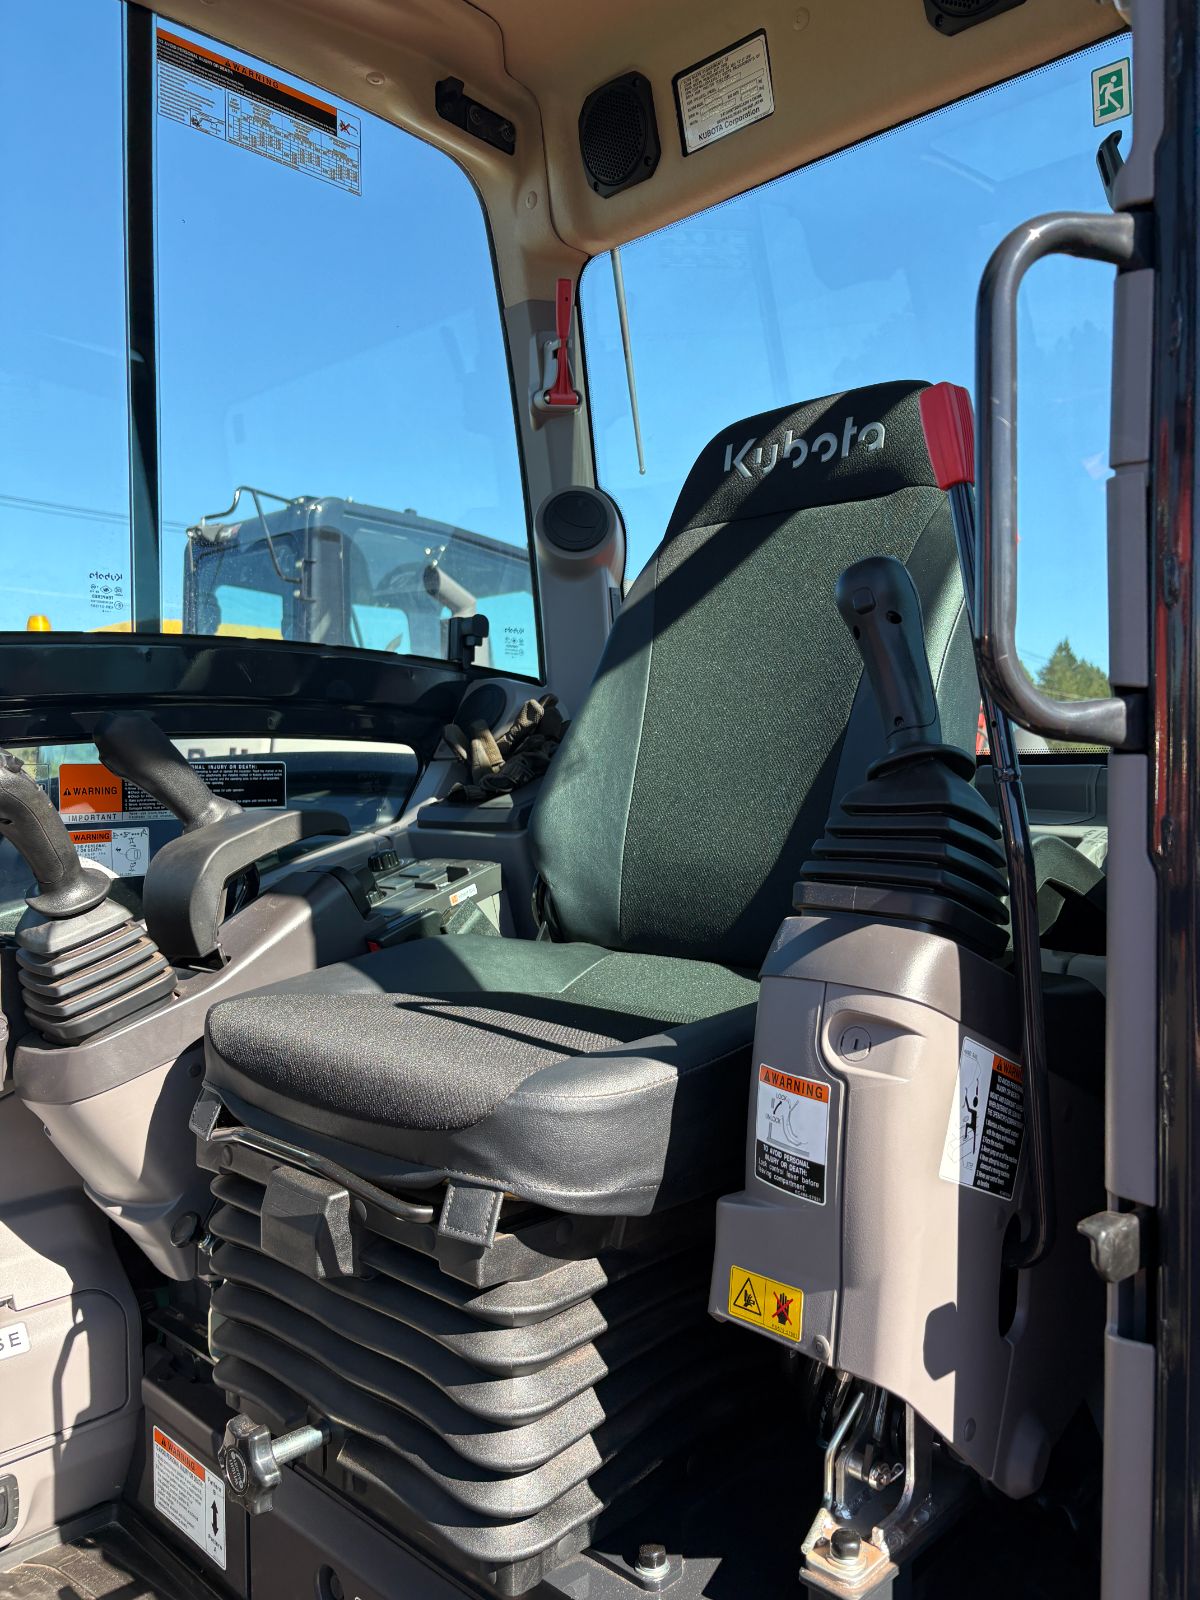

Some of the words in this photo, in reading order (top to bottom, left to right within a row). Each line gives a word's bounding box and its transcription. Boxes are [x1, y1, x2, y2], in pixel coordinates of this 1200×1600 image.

[233, 62, 280, 89] WARNING
[698, 124, 724, 141] KUBOTA
[724, 107, 760, 129] Corporation
[723, 416, 886, 478] Kubota
[73, 786, 118, 796] WARNING
[68, 813, 117, 822] IMPORTANT
[73, 832, 110, 842] WARNING
[772, 1072, 823, 1100] WARNING
[776, 1093, 788, 1101] LOCK
[763, 1143, 769, 1152] TO
[769, 1147, 783, 1159] AVOID
[783, 1153, 810, 1169] PERSONAL
[764, 1153, 780, 1166] INJURY
[780, 1160, 788, 1169] OR
[788, 1164, 808, 1177] DEATH:
[769, 1164, 784, 1175] control
[786, 1170, 799, 1181] lever
[801, 1176, 820, 1189] before
[167, 1441, 196, 1470] WARNING
